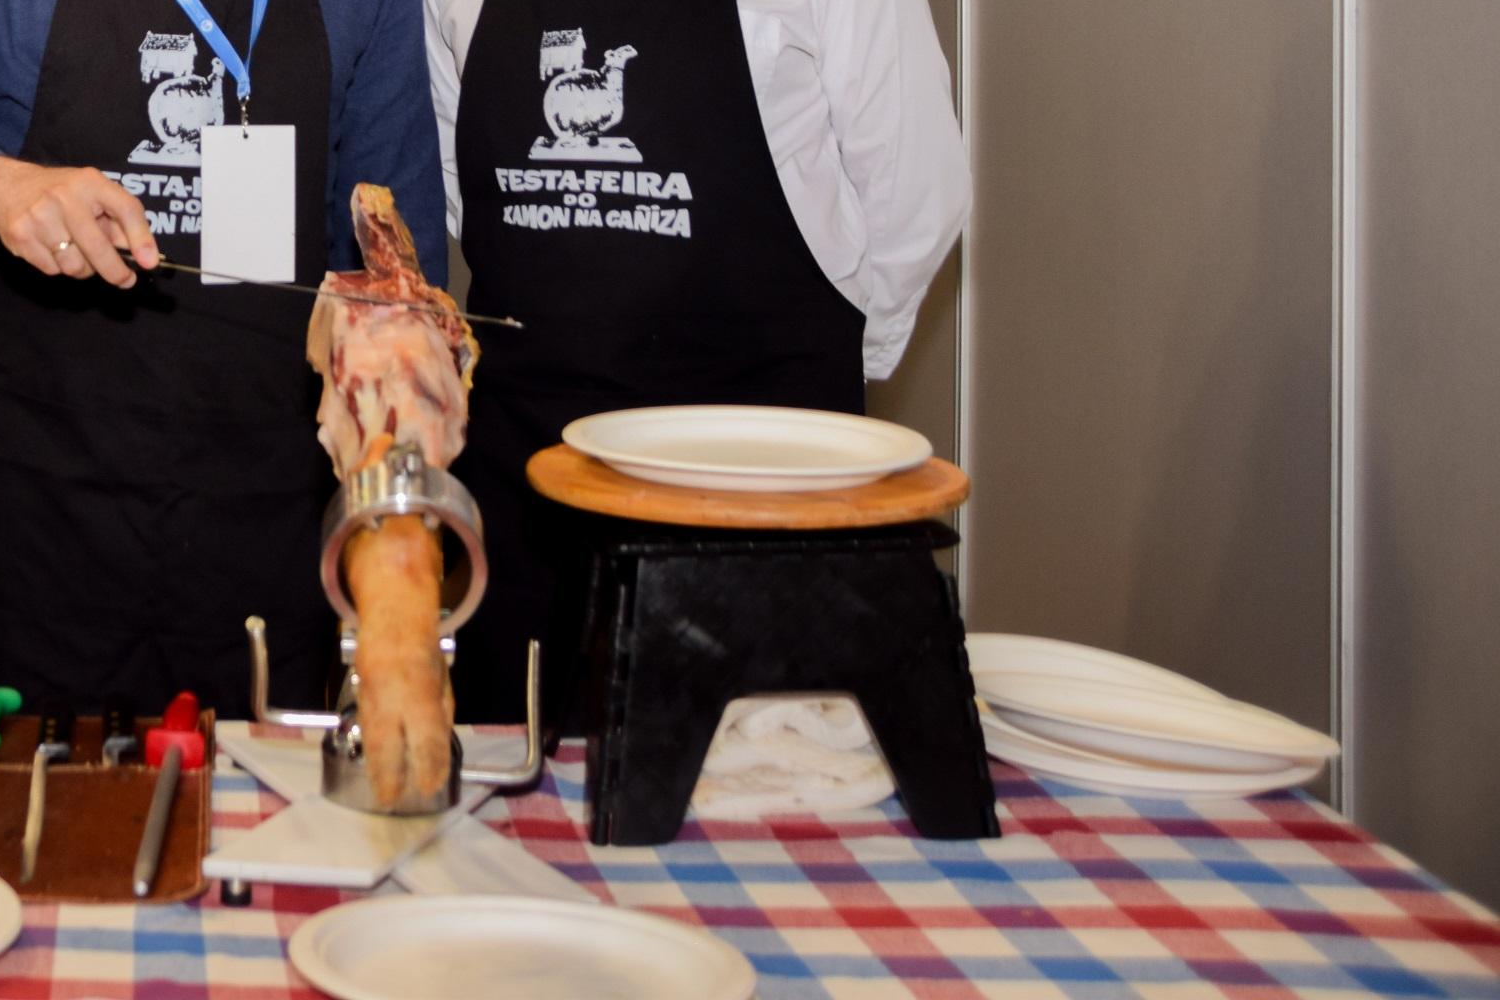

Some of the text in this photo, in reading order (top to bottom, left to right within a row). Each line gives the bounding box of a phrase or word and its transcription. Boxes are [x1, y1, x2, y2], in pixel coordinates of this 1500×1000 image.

[495, 167, 693, 200] FESTA-FEIRA
[169, 199, 201, 215] DO
[563, 193, 597, 208] DO
[574, 208, 604, 227] NA
